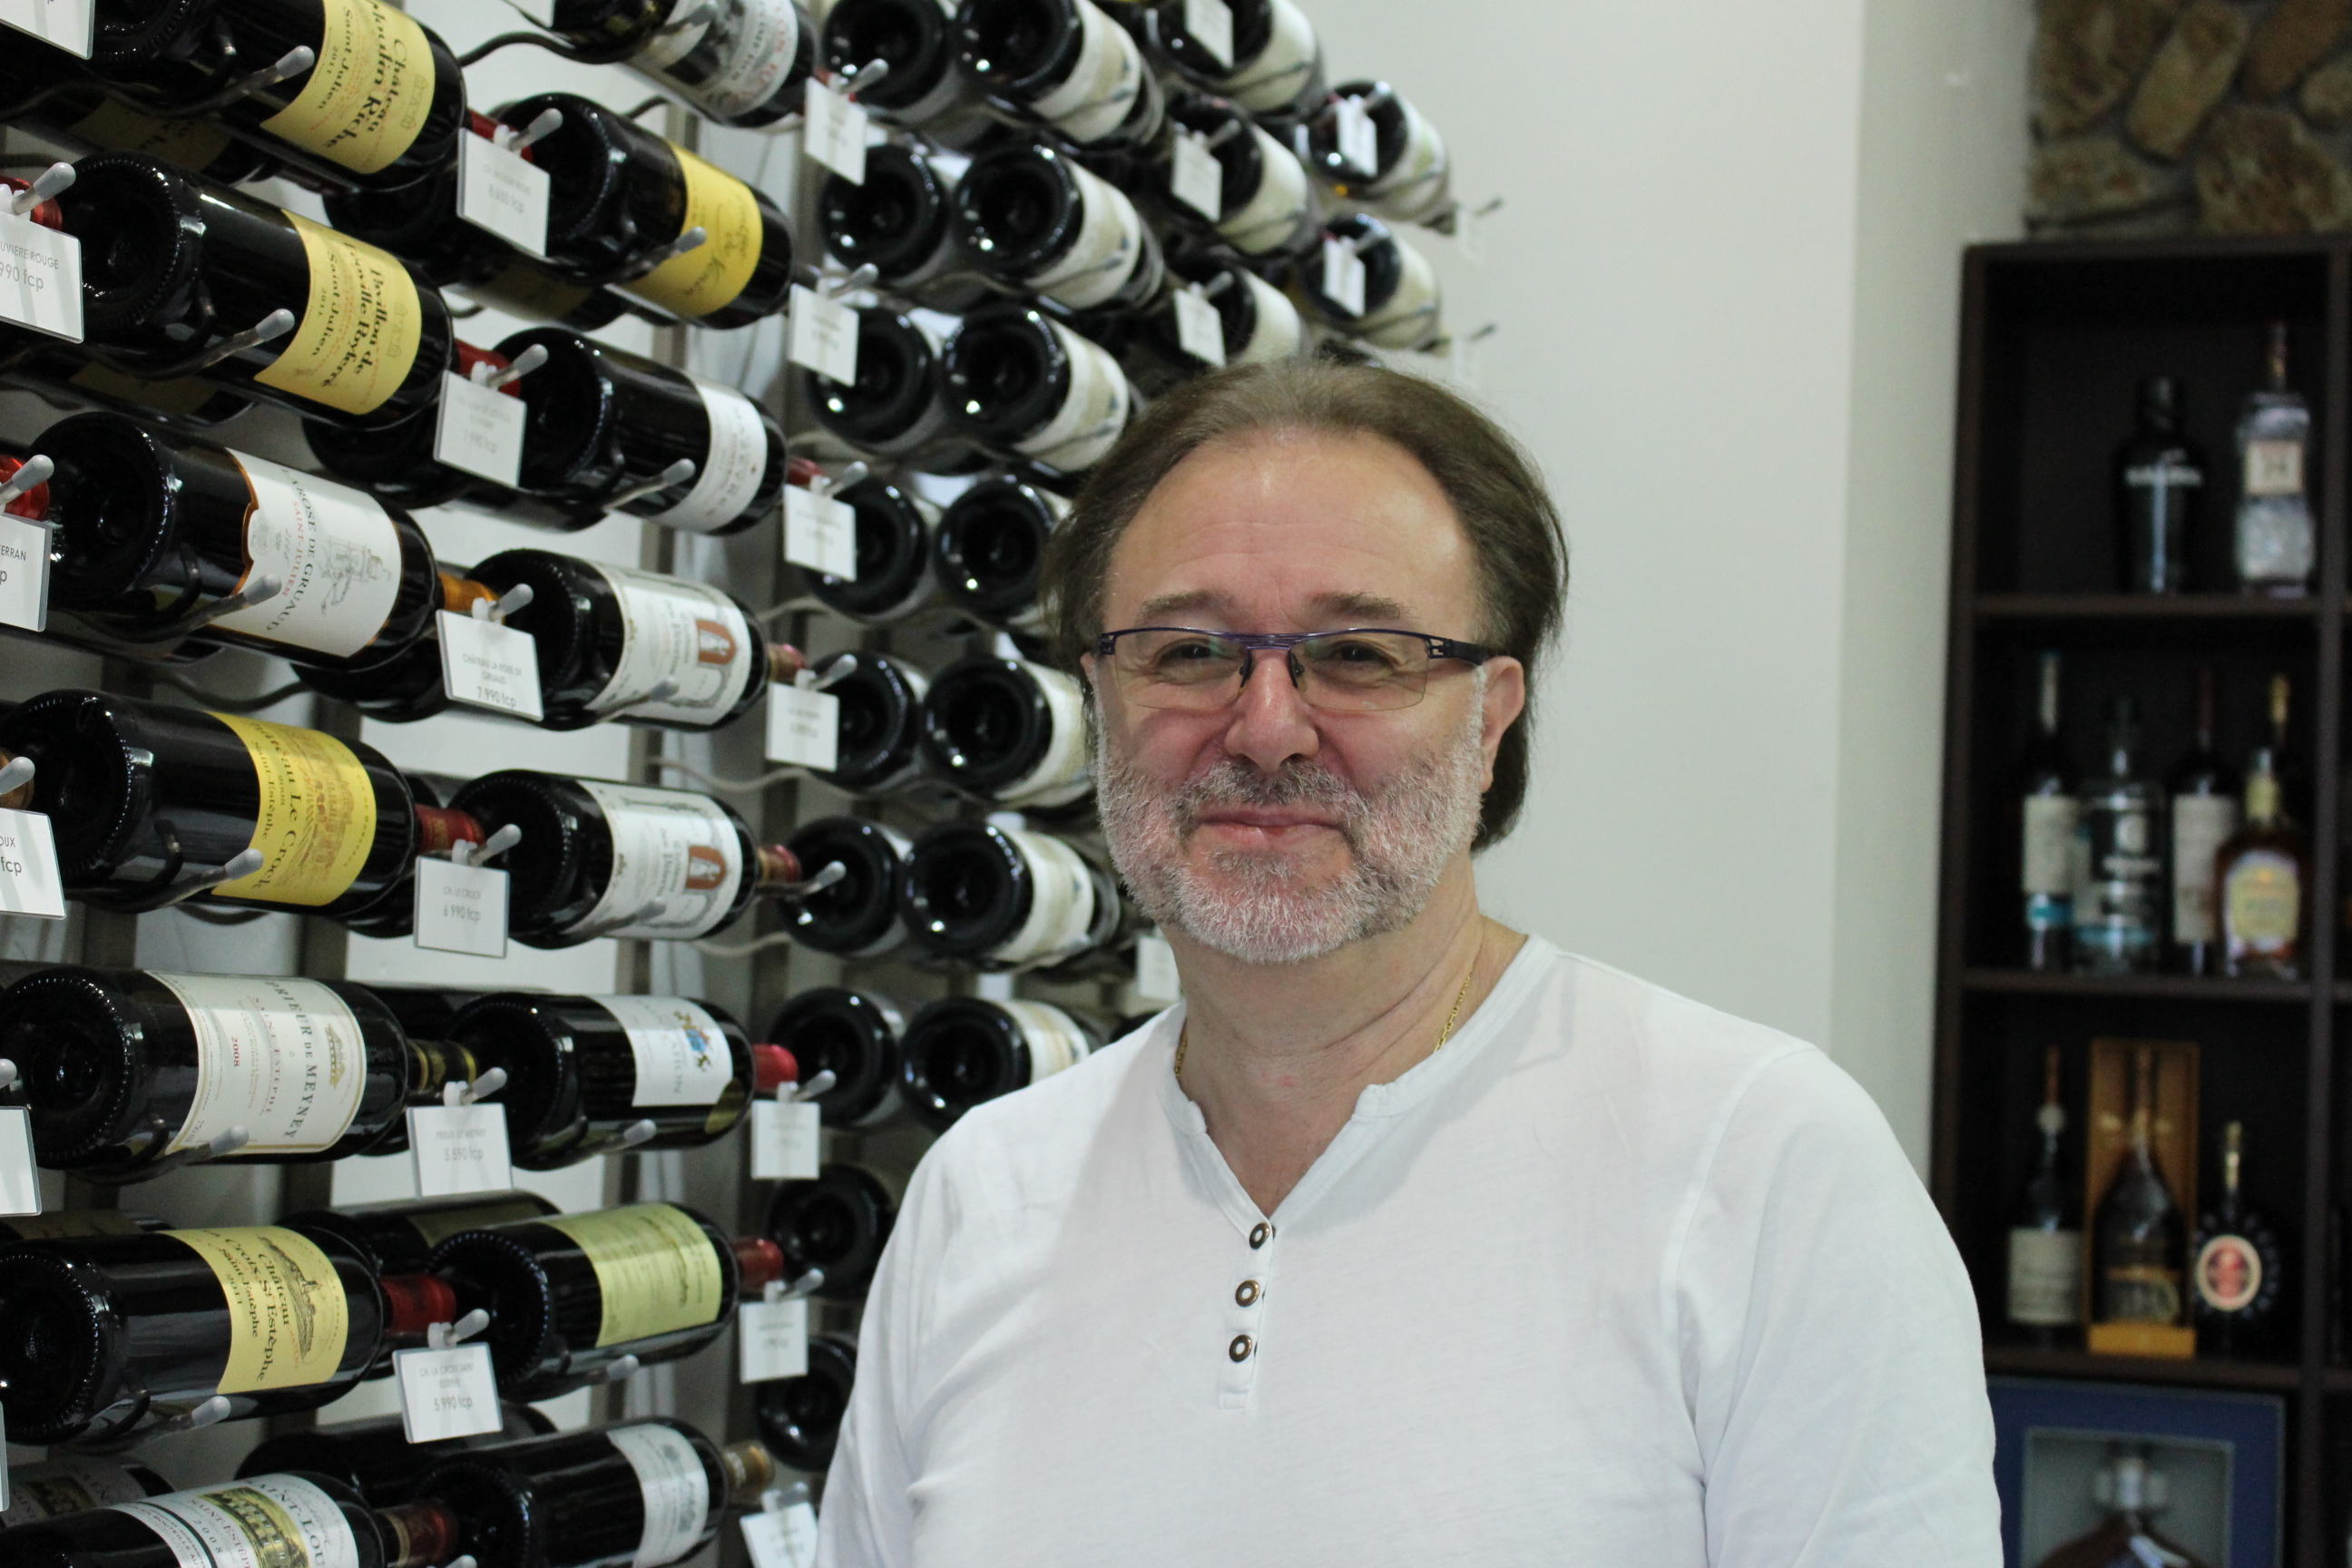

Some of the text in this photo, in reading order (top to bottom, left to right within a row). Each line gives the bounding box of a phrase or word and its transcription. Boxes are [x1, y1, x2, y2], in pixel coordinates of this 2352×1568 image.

[318, 57, 349, 110] Julien
[30, 250, 59, 270] ROUGE
[23, 269, 44, 292] fcp
[311, 251, 340, 357] Saint Julien
[356, 268, 387, 375] Pavillon de
[296, 486, 317, 534] ROSE
[307, 537, 317, 560] DE
[266, 563, 314, 632] GRUAUD
[501, 691, 517, 710] fcp
[288, 793, 302, 822] Le
[0, 856, 23, 877] fcp
[252, 828, 297, 890] Crock
[466, 906, 482, 924] fcp
[230, 1035, 240, 1067] 2008
[303, 1041, 313, 1058] DE
[283, 1063, 318, 1139] MEYNEY
[468, 1146, 484, 1162] fcp
[226, 1272, 243, 1306] 2011
[258, 1252, 290, 1327] Château
[256, 1303, 279, 1383] Estèphe
[441, 1396, 457, 1410] 990
[457, 1395, 473, 1411] fcp
